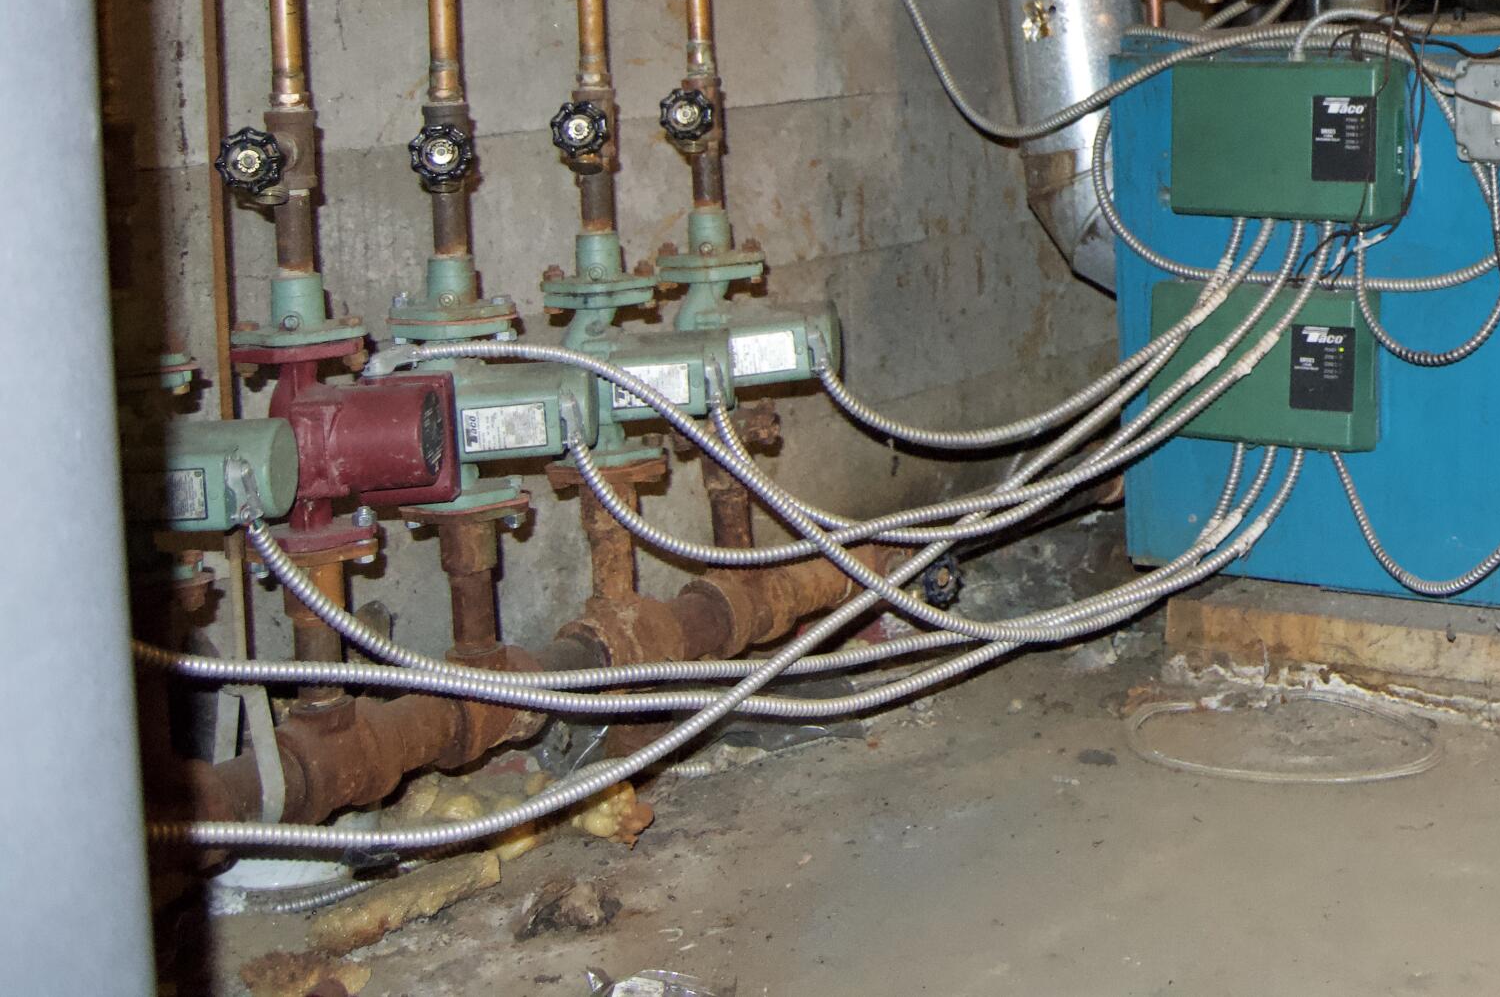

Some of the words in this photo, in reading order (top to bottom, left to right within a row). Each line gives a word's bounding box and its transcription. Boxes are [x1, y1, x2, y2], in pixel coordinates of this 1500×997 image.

[1323, 97, 1365, 114] Taco
[1302, 325, 1344, 344] Taco
[464, 414, 478, 447] Taco
